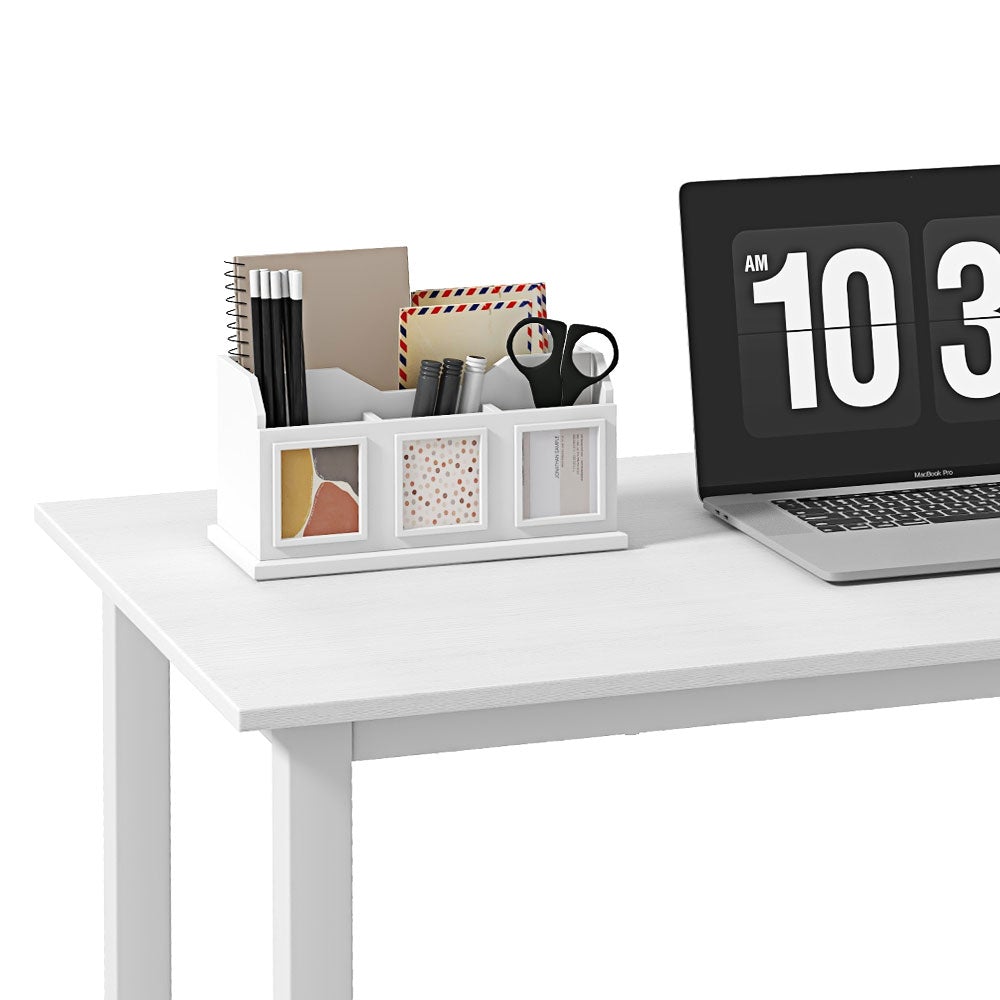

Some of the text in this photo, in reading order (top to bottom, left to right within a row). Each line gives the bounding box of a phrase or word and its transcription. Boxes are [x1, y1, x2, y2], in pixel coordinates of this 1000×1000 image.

[745, 254, 768, 272] AM
[753, 248, 900, 410] 10
[914, 470, 941, 478] MacBook
